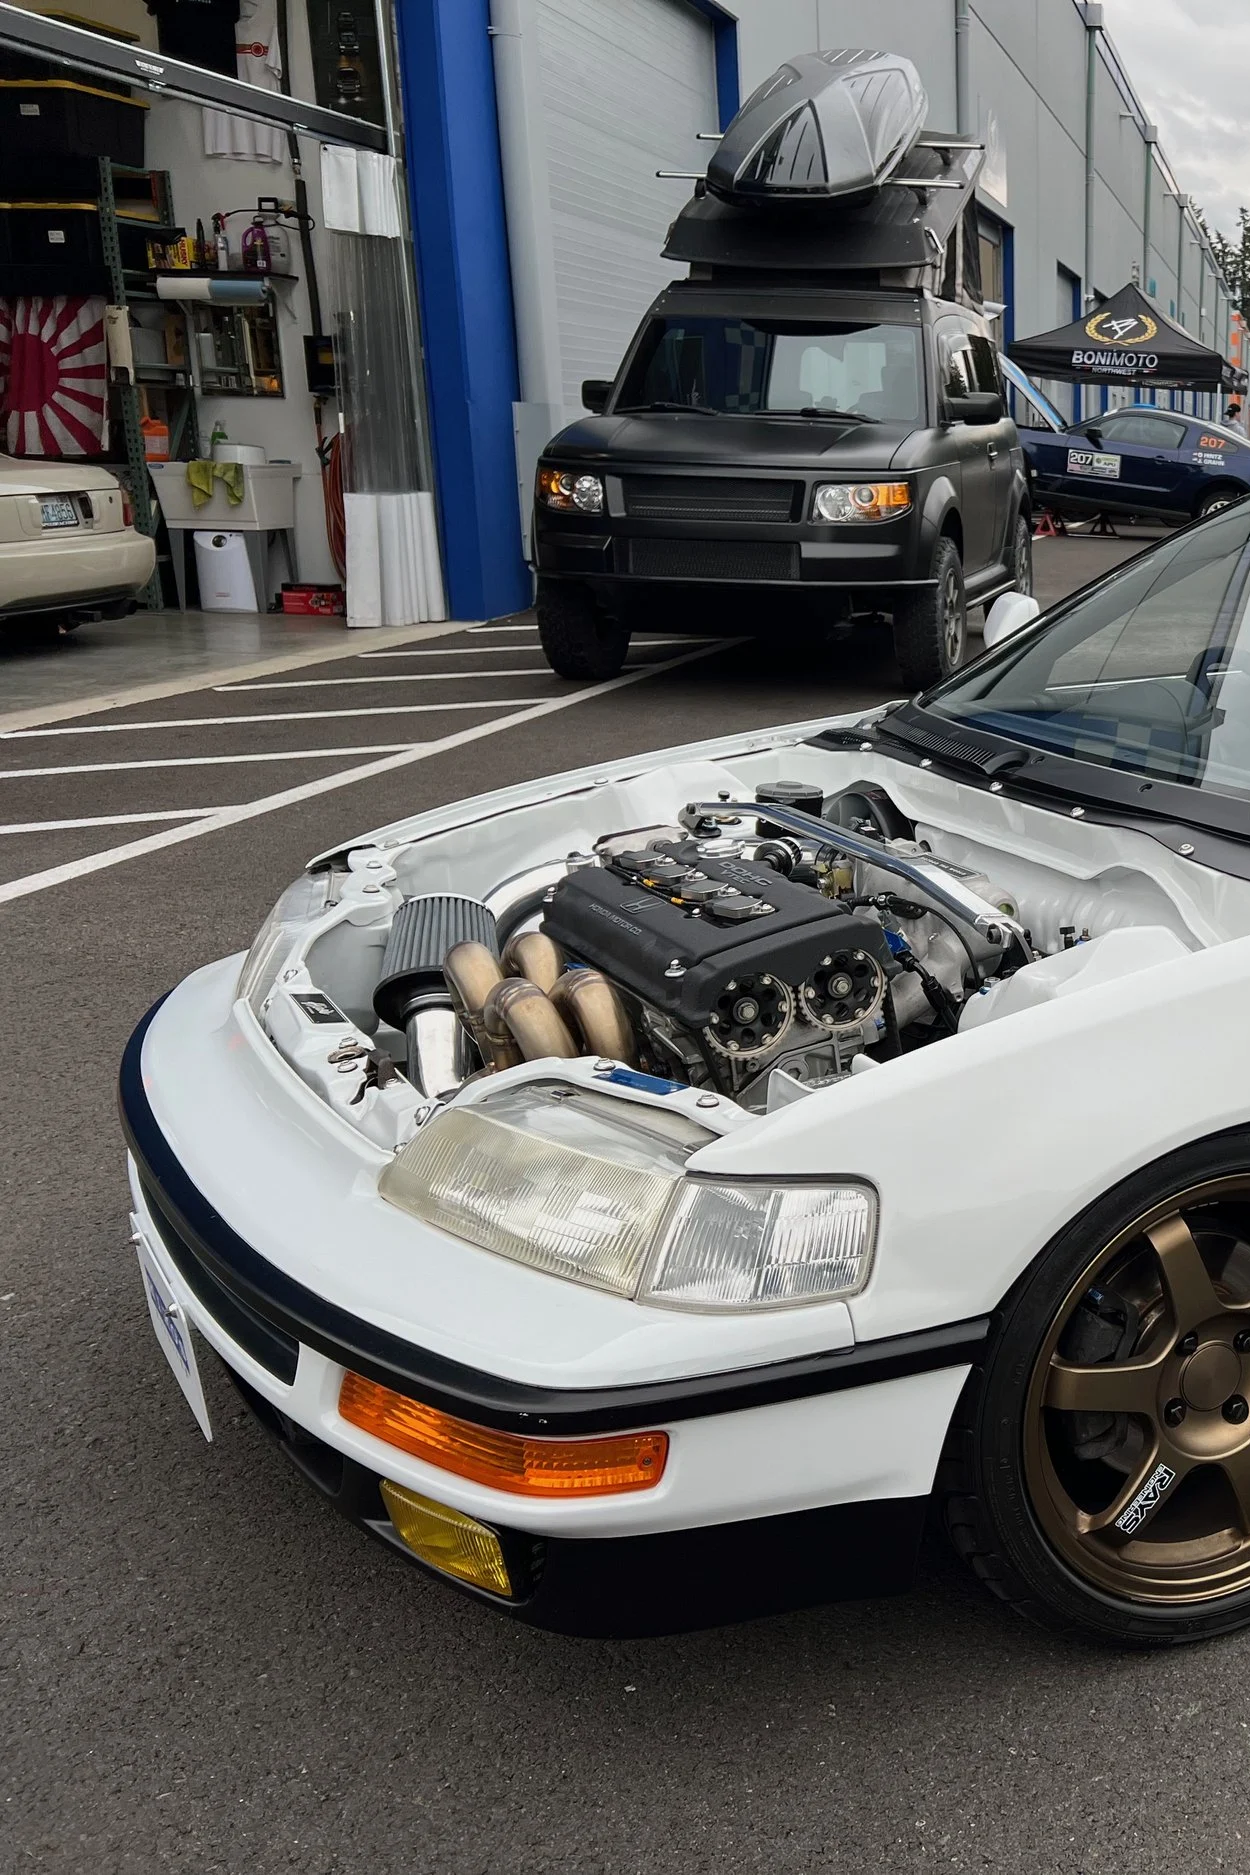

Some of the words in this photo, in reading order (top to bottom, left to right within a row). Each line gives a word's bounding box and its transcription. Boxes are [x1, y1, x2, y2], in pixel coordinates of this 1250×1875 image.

[1072, 350, 1158, 368] BONIMOTO
[1092, 367, 1137, 376] NORTHWEST
[1200, 436, 1226, 449] 207
[1070, 452, 1093, 465] 207
[718, 861, 773, 887] DOHC
[720, 869, 751, 885] VTEC
[588, 902, 613, 921] HONDA
[608, 911, 634, 931] MOTOR
[1114, 1463, 1165, 1528] ENGINEERING
[1120, 1466, 1176, 1535] RAYS
